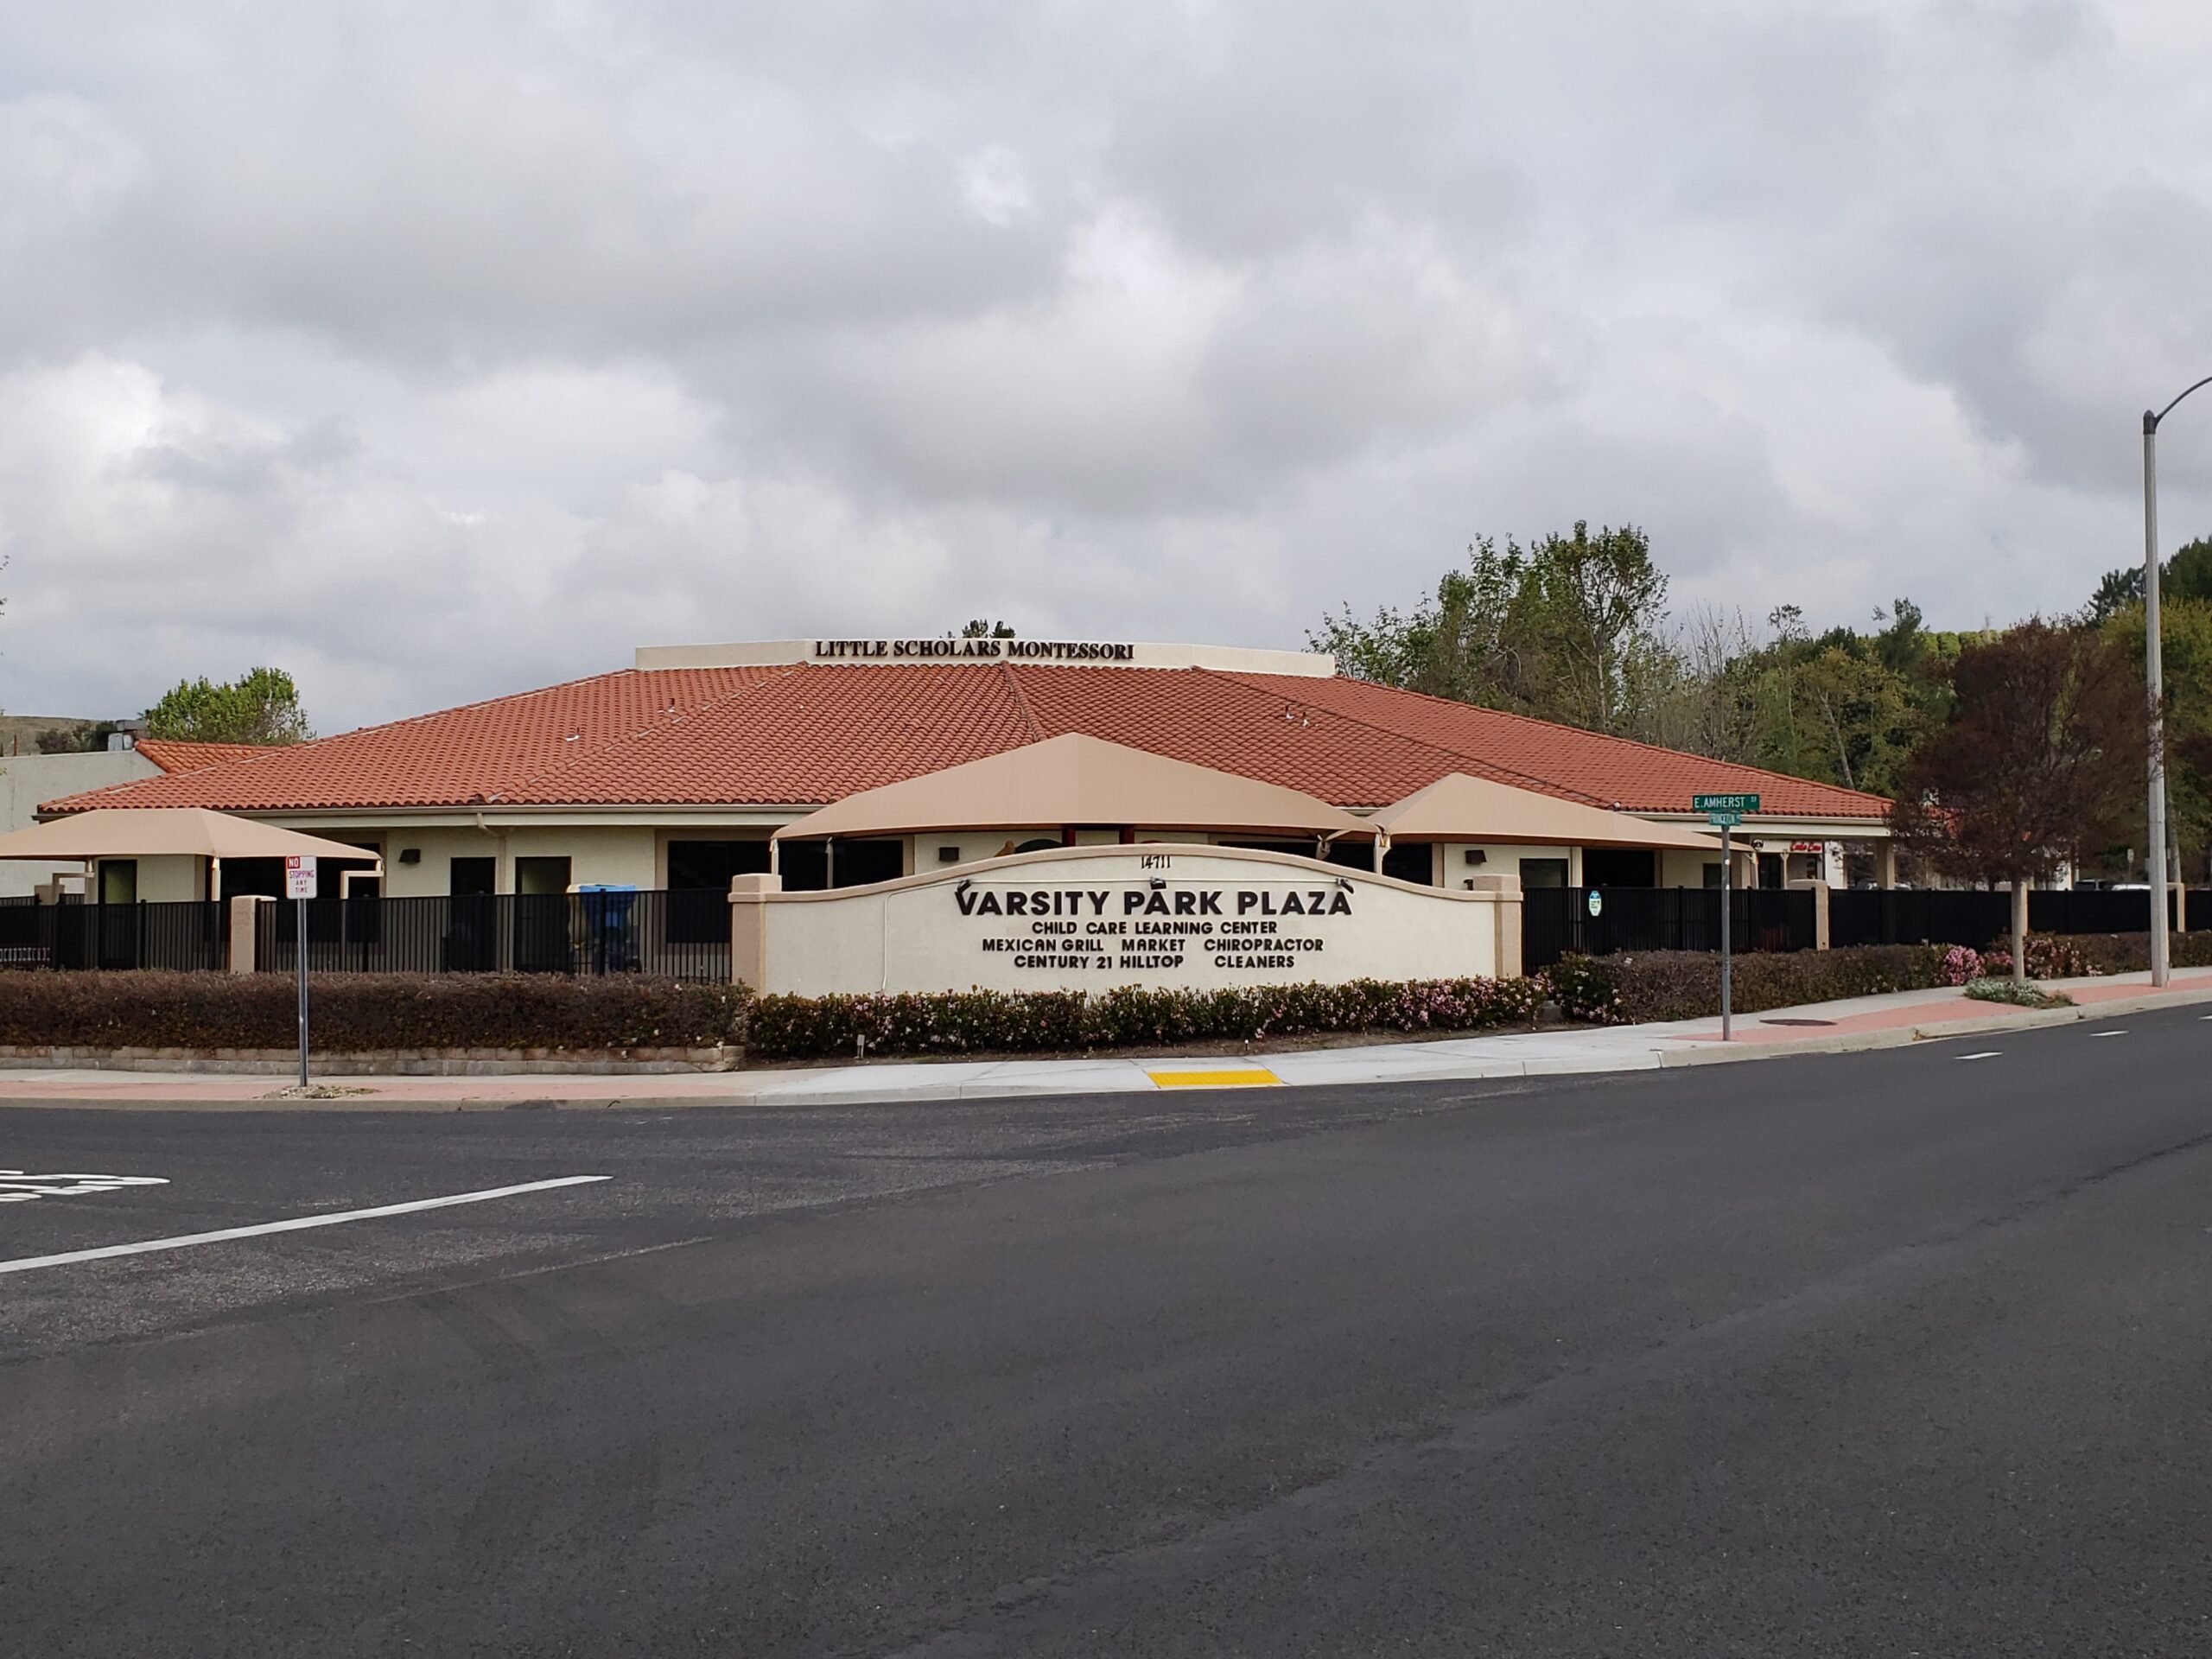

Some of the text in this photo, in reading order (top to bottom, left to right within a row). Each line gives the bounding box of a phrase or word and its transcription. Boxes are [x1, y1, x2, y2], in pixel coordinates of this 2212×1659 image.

[816, 640, 1134, 659] LITTLE SCHOLARS MONTESSORI
[289, 857, 299, 868] NO
[1141, 855, 1171, 869] 14711
[289, 870, 315, 879] STOPPING
[955, 891, 1352, 915] VARSITY PARK PLAZA
[1032, 921, 1277, 934] CHILD CARE LEARNING CENTER
[982, 938, 1104, 951] MEXICAN GRILL
[1122, 938, 1185, 951] MARKET
[1205, 938, 1324, 951] CHIROPRACTOR
[1014, 955, 1184, 969] CENTURY 21 HILLTOP
[1215, 955, 1294, 969] CLEANERS
